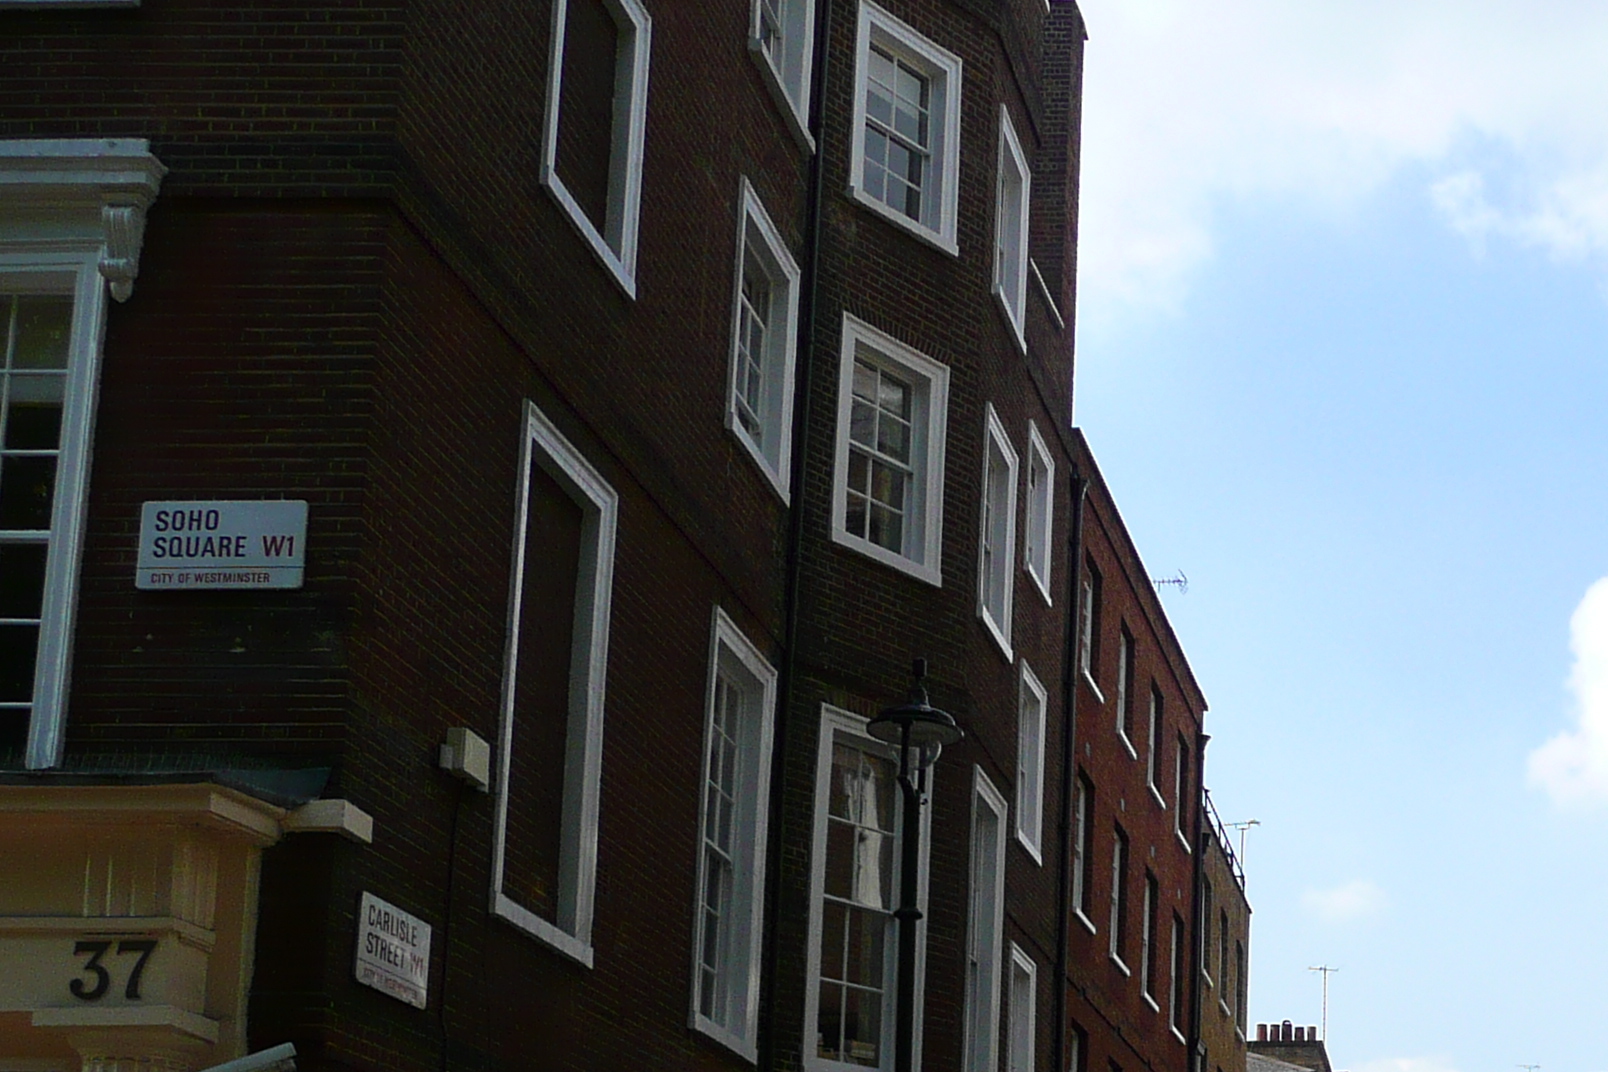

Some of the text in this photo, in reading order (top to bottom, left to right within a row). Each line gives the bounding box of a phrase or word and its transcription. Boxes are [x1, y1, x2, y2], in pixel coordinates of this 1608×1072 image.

[155, 509, 220, 532] SOHO
[153, 534, 295, 558] SQUARE W1
[150, 572, 271, 584] CITY OF WESTMINSTER
[368, 903, 418, 948] CARLISLE
[365, 931, 408, 969] STREET
[69, 940, 158, 1000] 37
